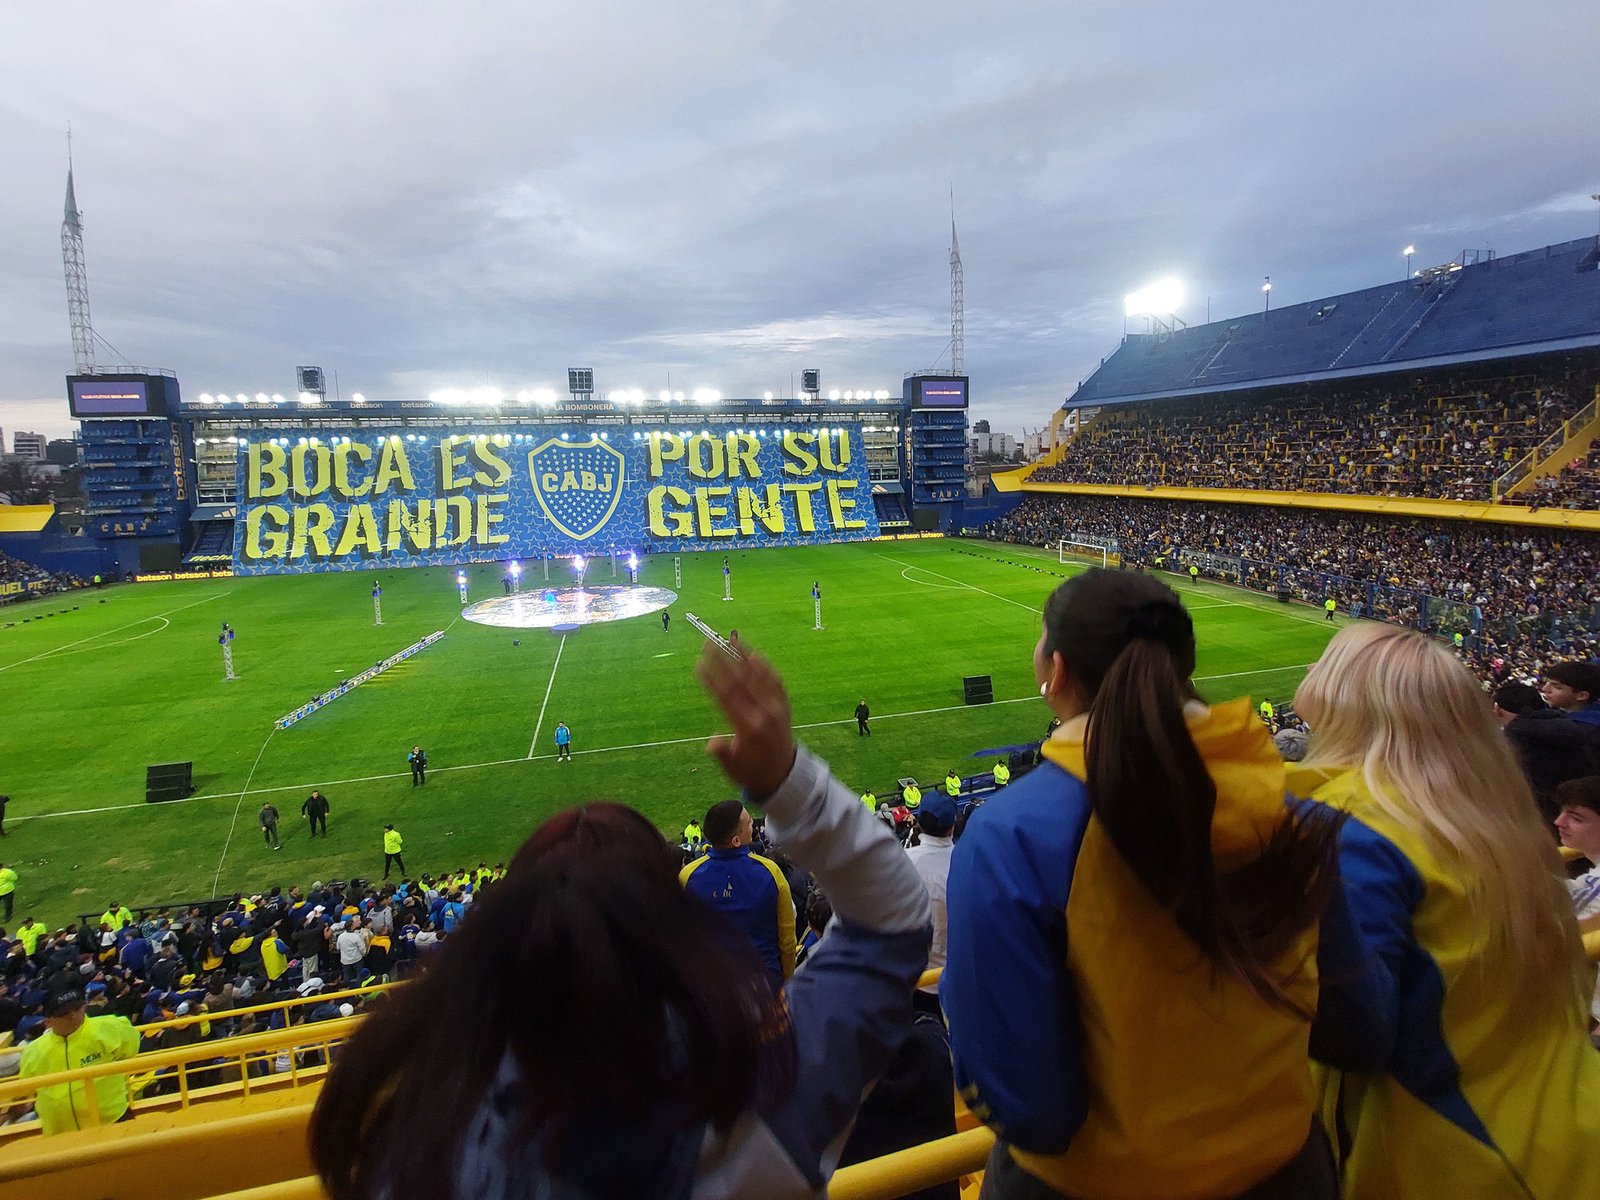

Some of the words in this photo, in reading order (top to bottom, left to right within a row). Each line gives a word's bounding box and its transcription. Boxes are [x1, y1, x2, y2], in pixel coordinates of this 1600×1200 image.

[188, 402, 224, 410] betsson
[553, 402, 563, 411] LA
[565, 402, 614, 411] BOMBONERA
[171, 422, 185, 501] betsson
[248, 438, 416, 499] BOCA
[441, 434, 512, 491] ES
[649, 431, 762, 480] POR
[783, 429, 850, 477] SU
[541, 470, 613, 493] CABJ
[246, 494, 510, 559] GRANDE
[647, 479, 867, 537] GENTE
[920, 531, 944, 539] betsson
[136, 574, 172, 582] betsson
[174, 572, 210, 580] betsson
